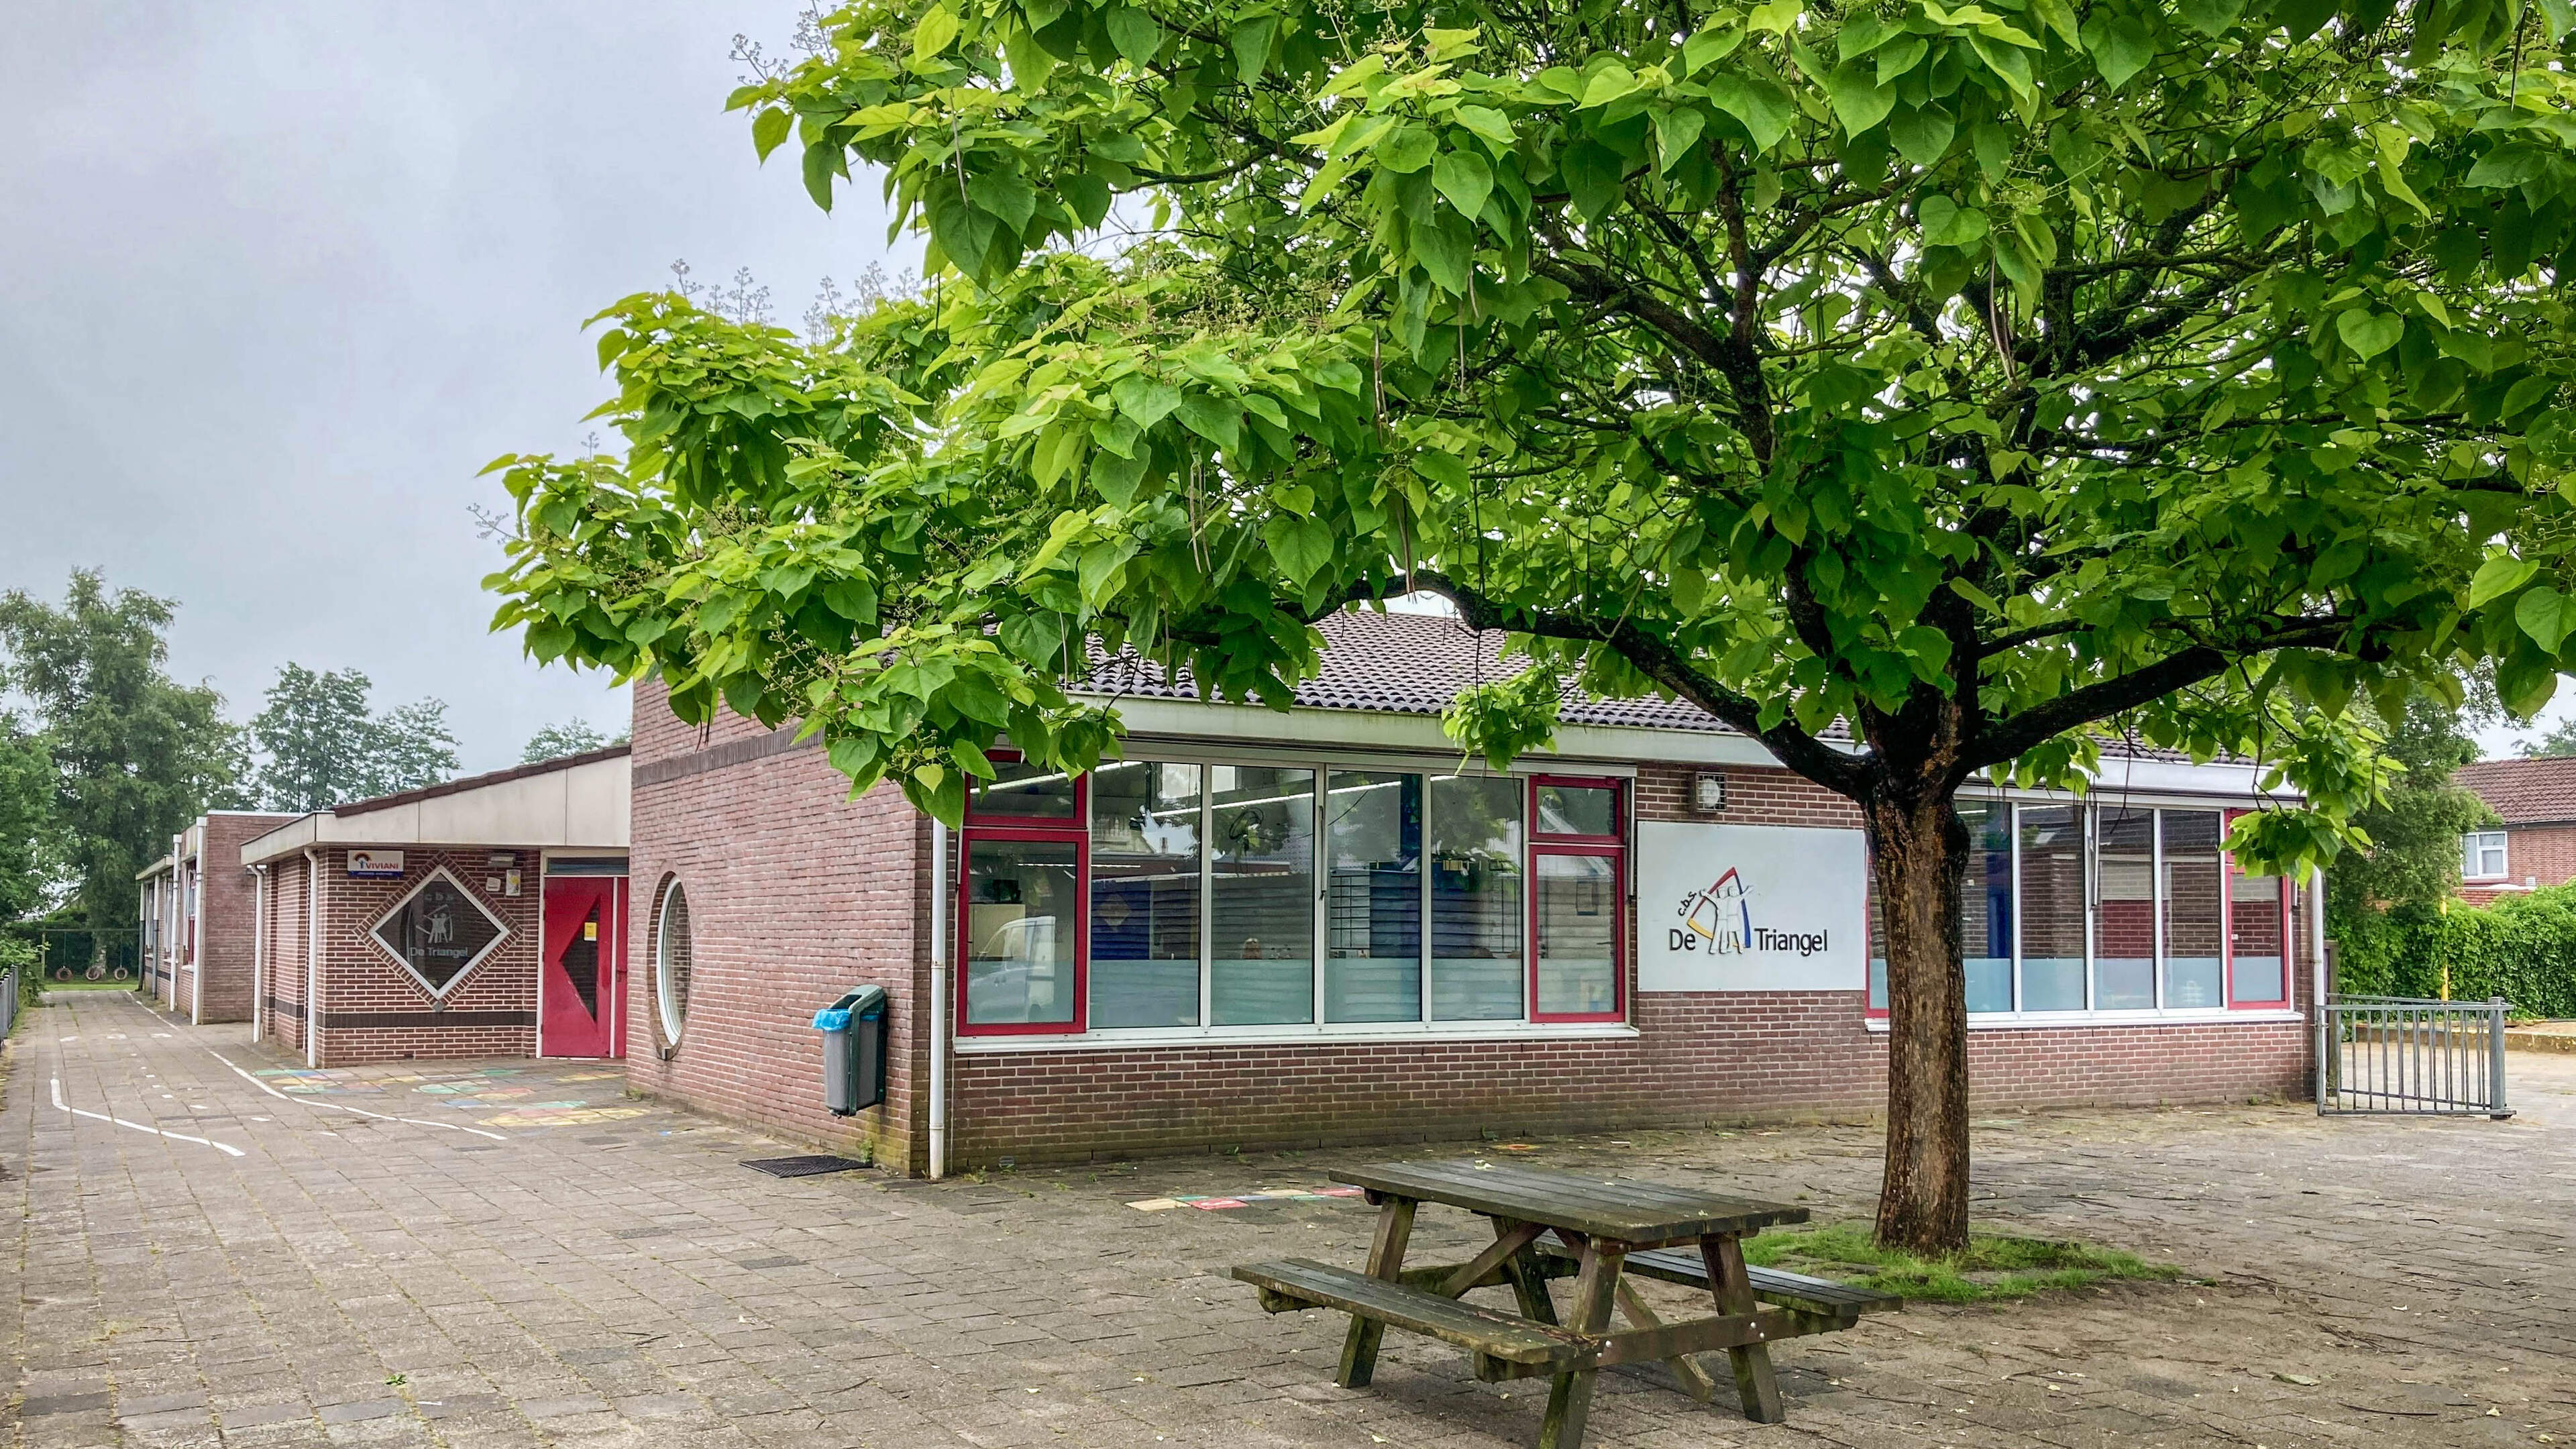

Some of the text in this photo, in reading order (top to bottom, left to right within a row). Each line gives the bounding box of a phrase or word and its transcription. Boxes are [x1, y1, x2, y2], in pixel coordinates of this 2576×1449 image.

[1678, 890, 1697, 917] c.b.s.
[410, 947, 468, 959] De Triangel
[1668, 928, 1828, 957] De Triangel
